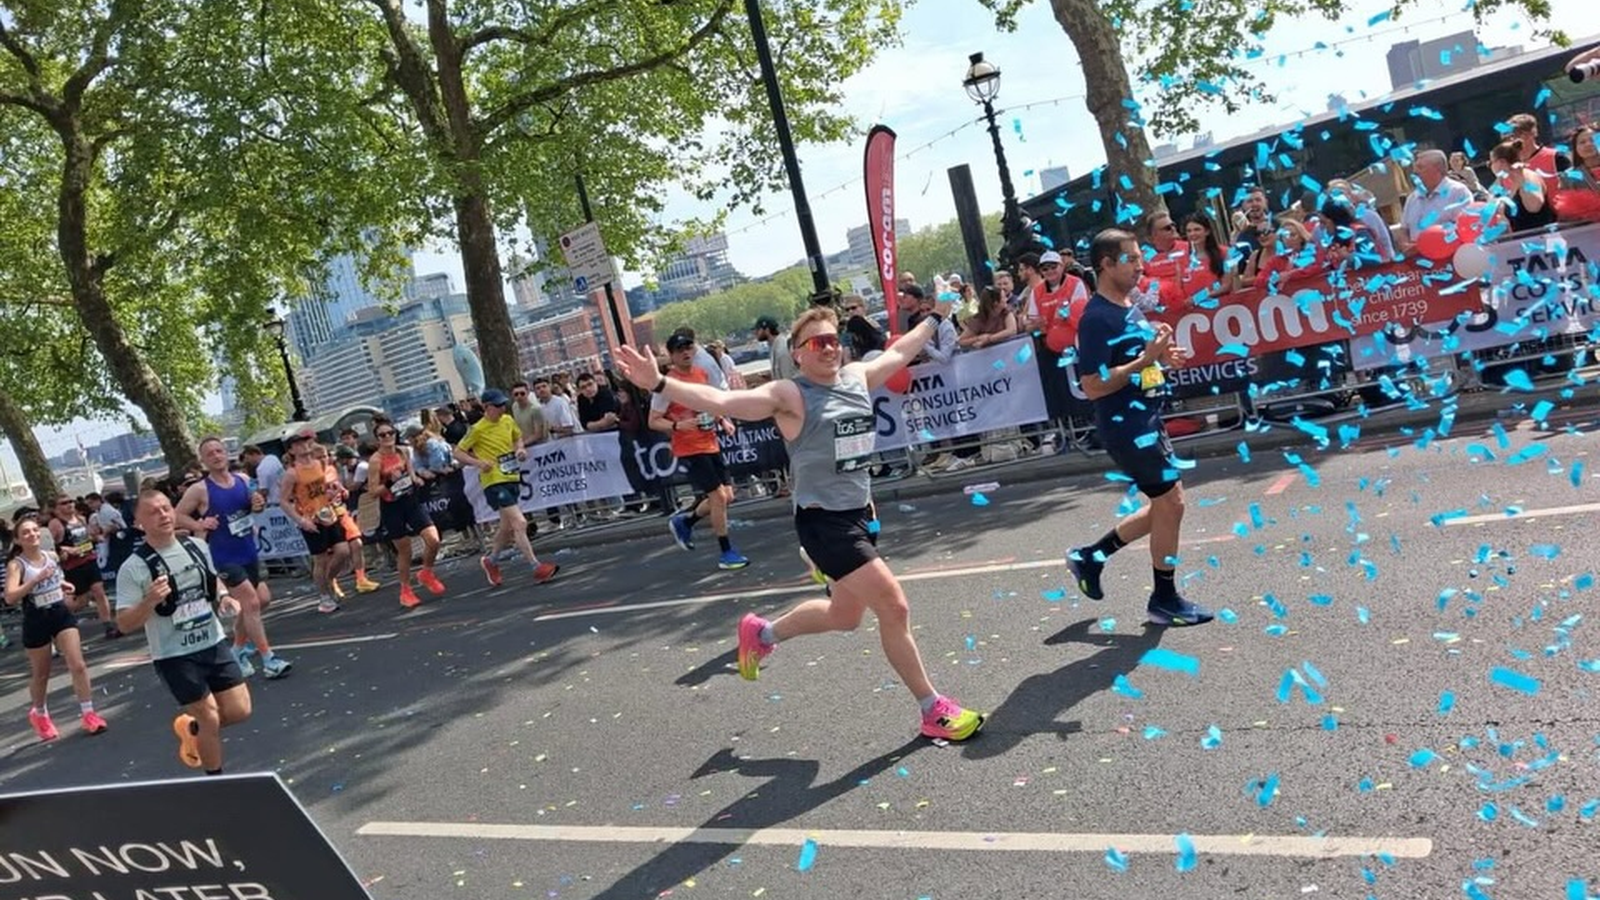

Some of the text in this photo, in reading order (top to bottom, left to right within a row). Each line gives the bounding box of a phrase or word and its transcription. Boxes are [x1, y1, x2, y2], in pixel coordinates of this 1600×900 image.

[882, 188, 894, 281] coram
[1507, 247, 1587, 276] TATA
[1369, 284, 1425, 304] children
[1392, 299, 1428, 319] 1739
[1150, 286, 1330, 359] ram
[903, 374, 945, 395] ATA
[1168, 358, 1259, 387] SERVICES
[902, 377, 1012, 414] CONSULTANCY
[906, 406, 977, 433] SERVICES
[717, 426, 780, 448] NSULTANC
[534, 450, 566, 467] TATA
[722, 448, 758, 465] VICES
[540, 479, 588, 498] SERVICES
[0, 838, 246, 883] UN NOW,
